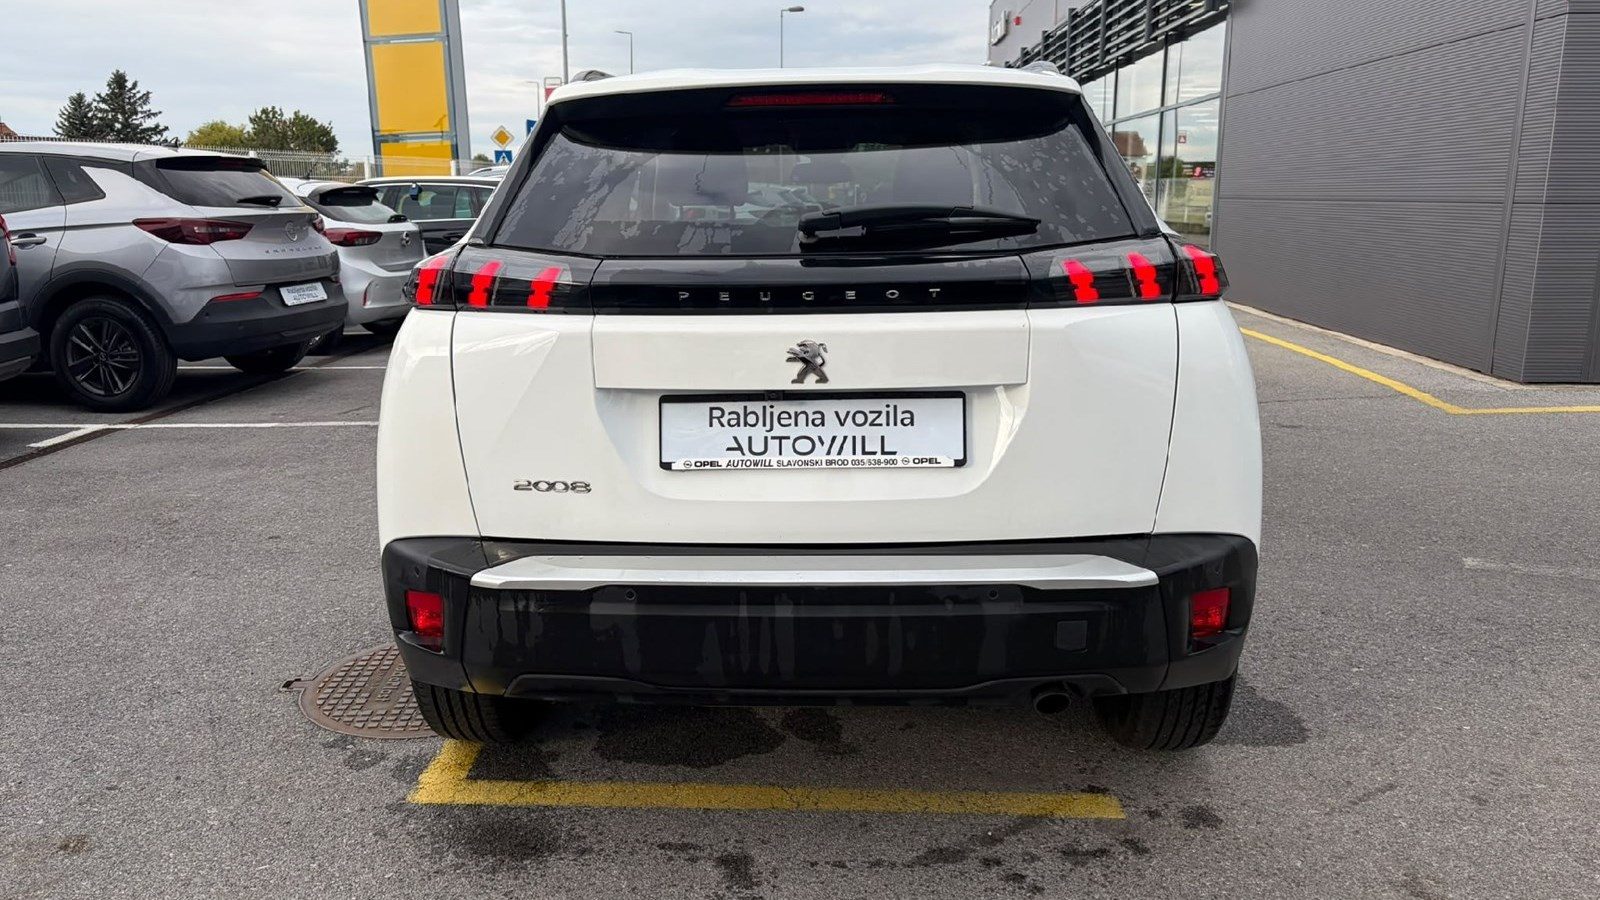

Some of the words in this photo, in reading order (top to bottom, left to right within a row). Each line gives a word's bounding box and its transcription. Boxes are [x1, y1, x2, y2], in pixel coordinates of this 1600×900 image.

[678, 288, 941, 301] PEUGEOT
[708, 405, 826, 432] Rabljena
[834, 404, 915, 427] vozila
[725, 435, 898, 456] AUTOWILL
[694, 460, 722, 468] OPEL
[726, 459, 774, 468] AUTOWILL
[777, 459, 822, 467] SLAVONSKI
[825, 459, 848, 467] BROD
[912, 457, 941, 465] OPEL
[513, 480, 592, 493] 2008
